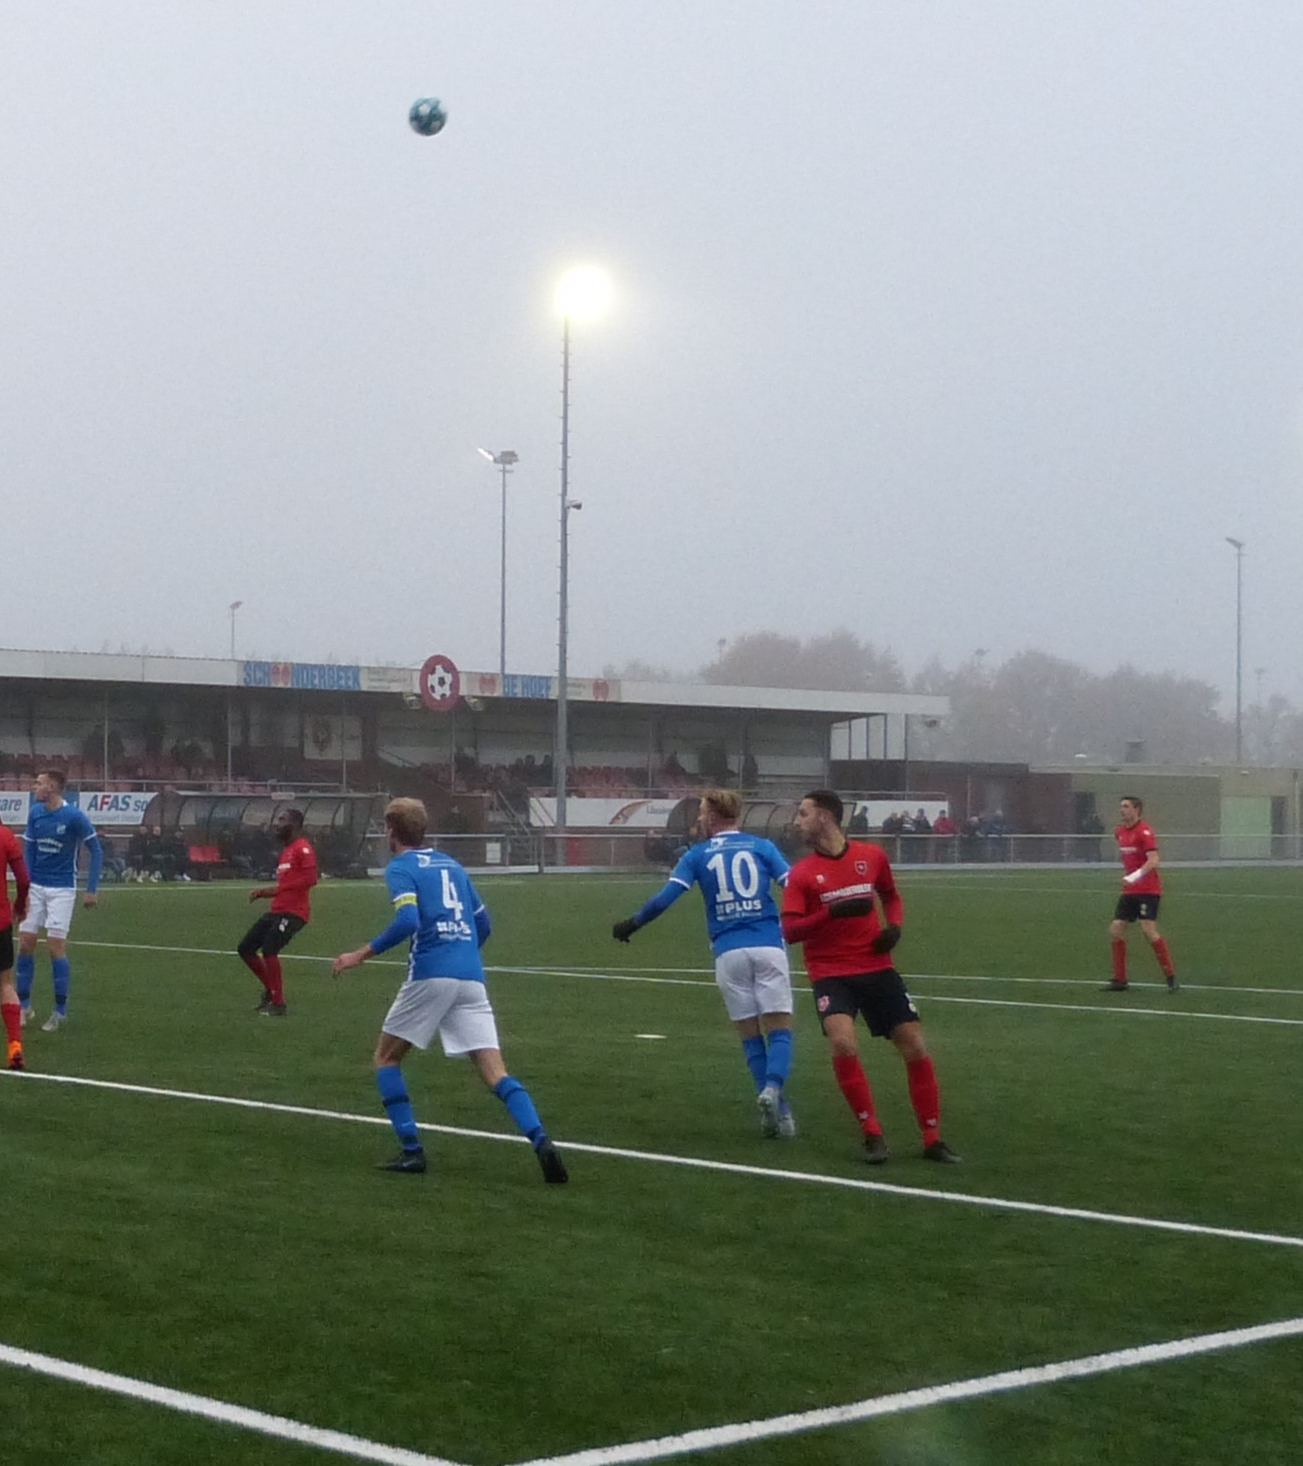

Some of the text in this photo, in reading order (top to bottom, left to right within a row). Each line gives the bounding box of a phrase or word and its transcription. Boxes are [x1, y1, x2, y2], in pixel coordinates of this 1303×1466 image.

[87, 795, 131, 811] AFAS
[706, 851, 759, 902] 10
[441, 869, 464, 921] 4
[725, 899, 762, 914] PLUS
